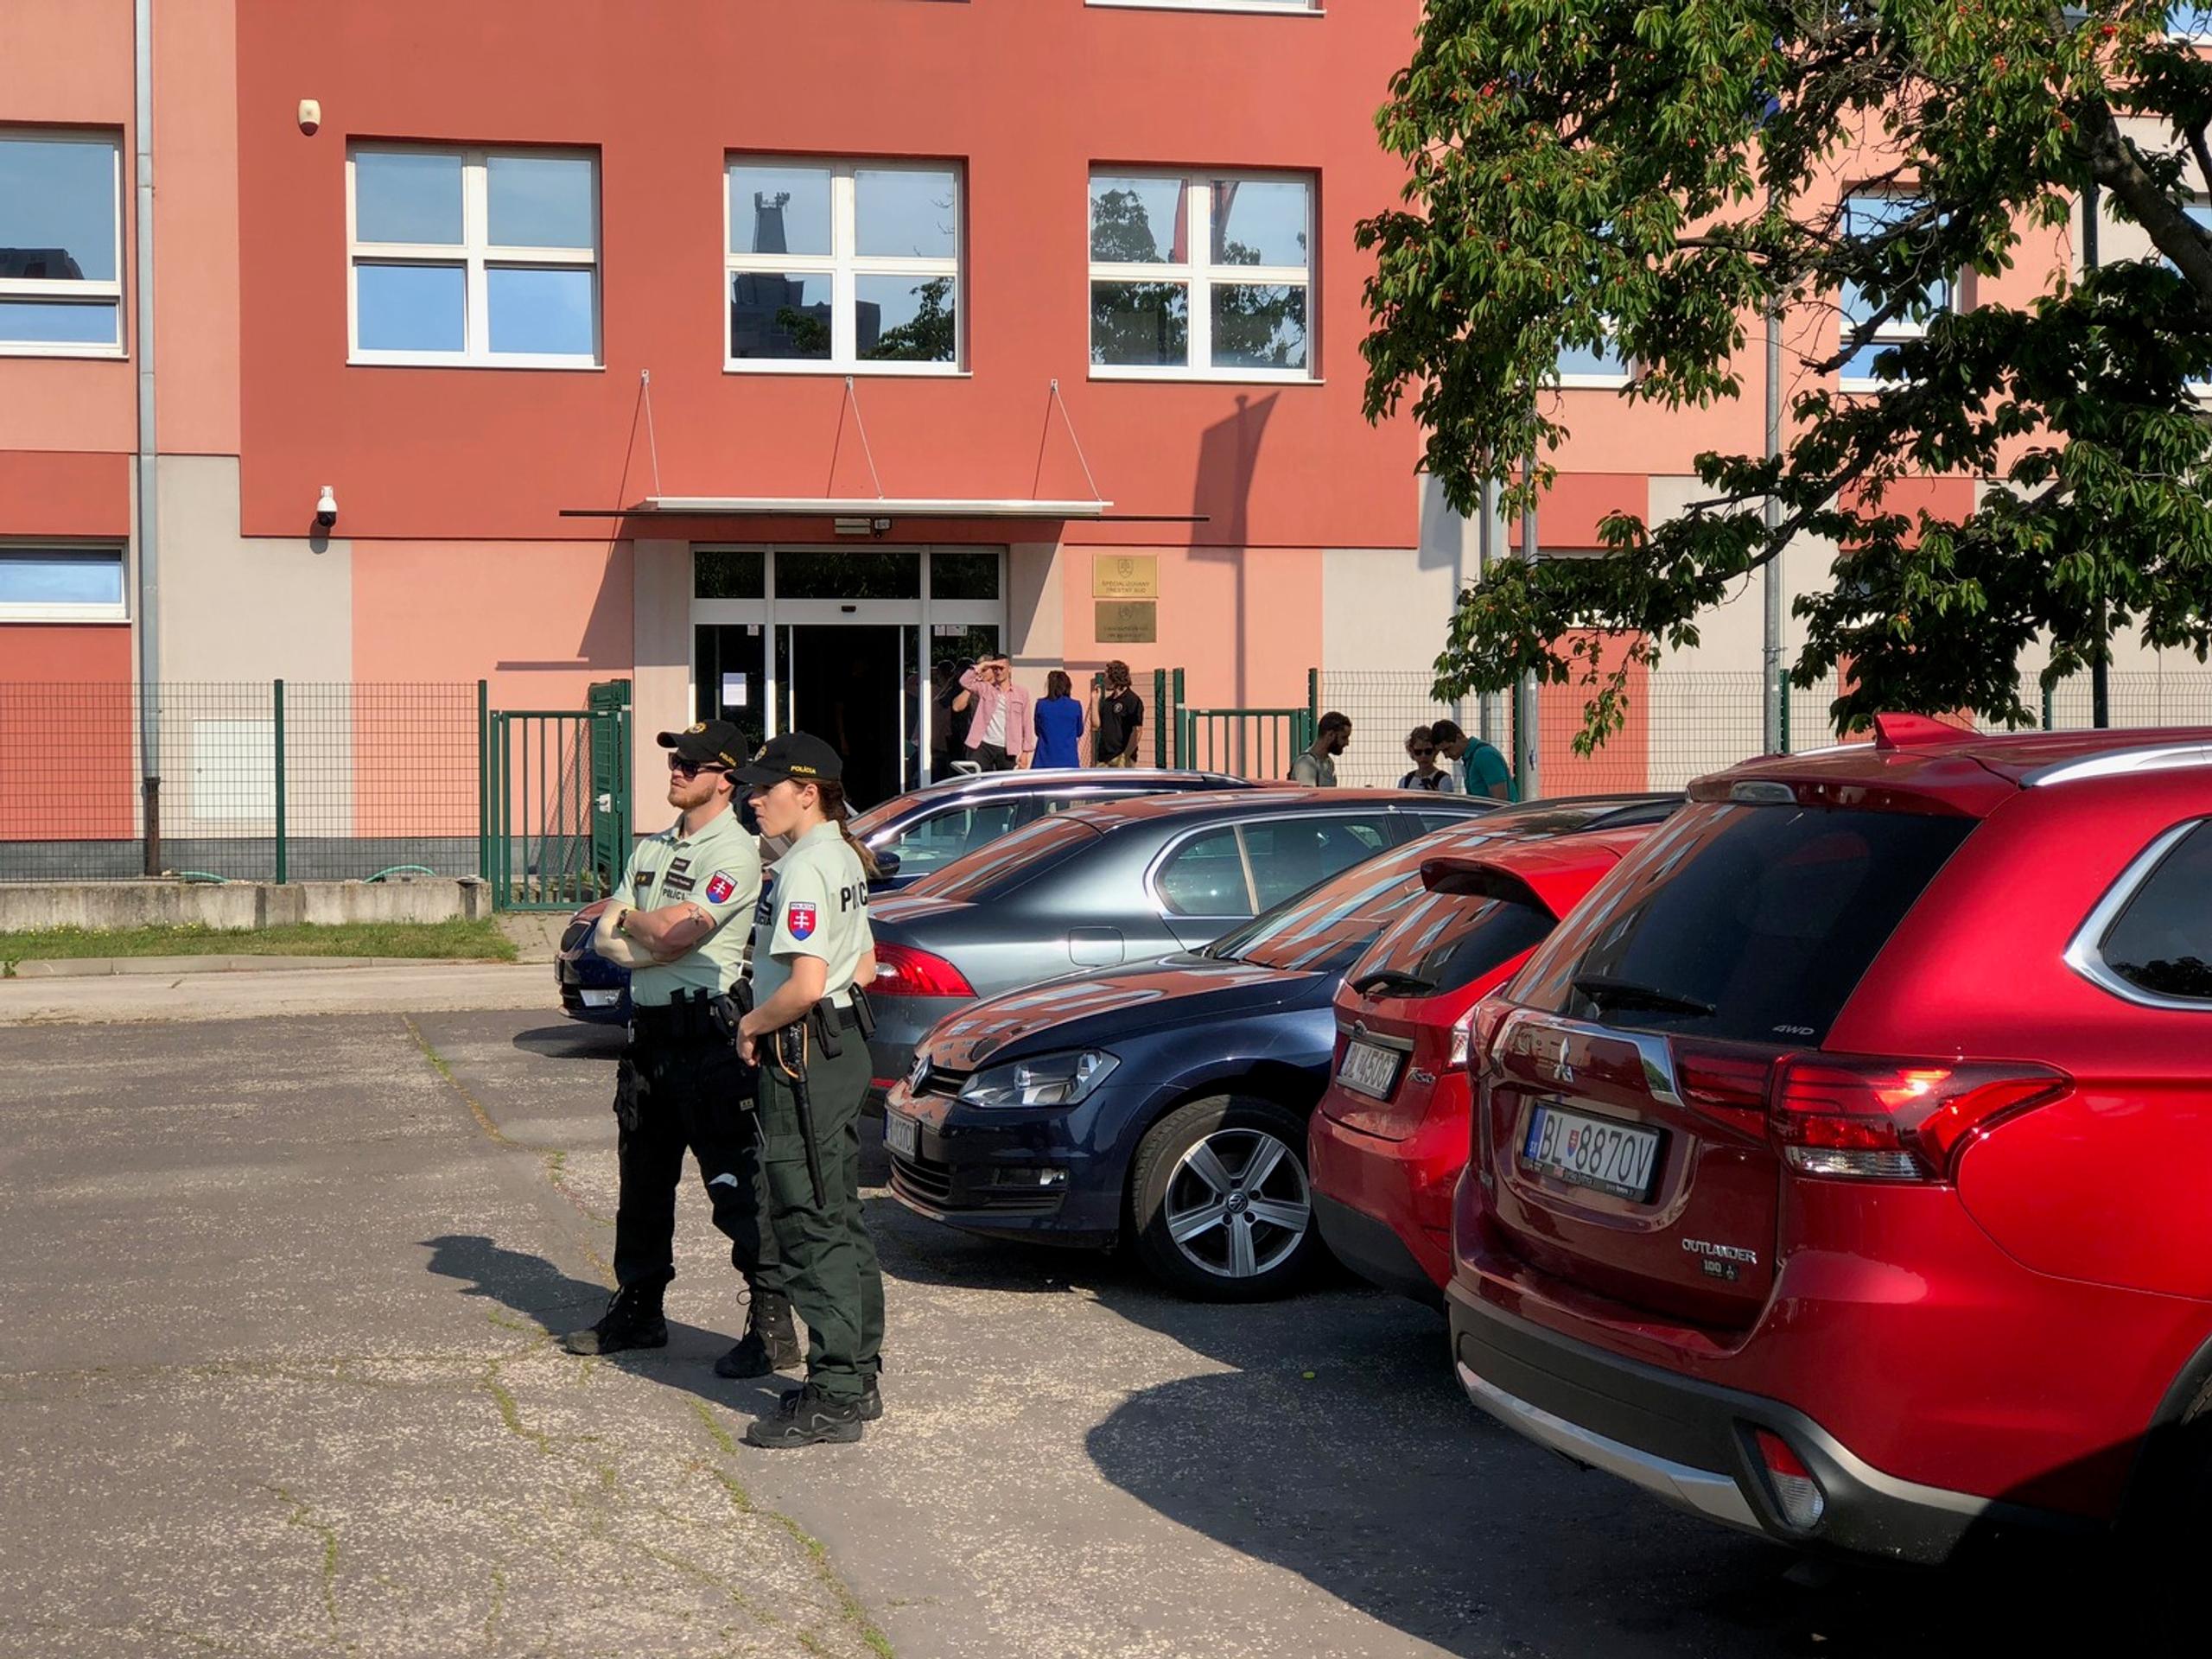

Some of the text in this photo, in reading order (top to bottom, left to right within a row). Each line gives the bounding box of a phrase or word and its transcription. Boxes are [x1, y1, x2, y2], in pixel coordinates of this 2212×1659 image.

[790, 765, 817, 775] POLÍCIA
[1772, 1025, 1815, 1035] 4WD
[1539, 1115, 1564, 1165] BL
[1681, 1237, 1758, 1264] OUTLANDER
